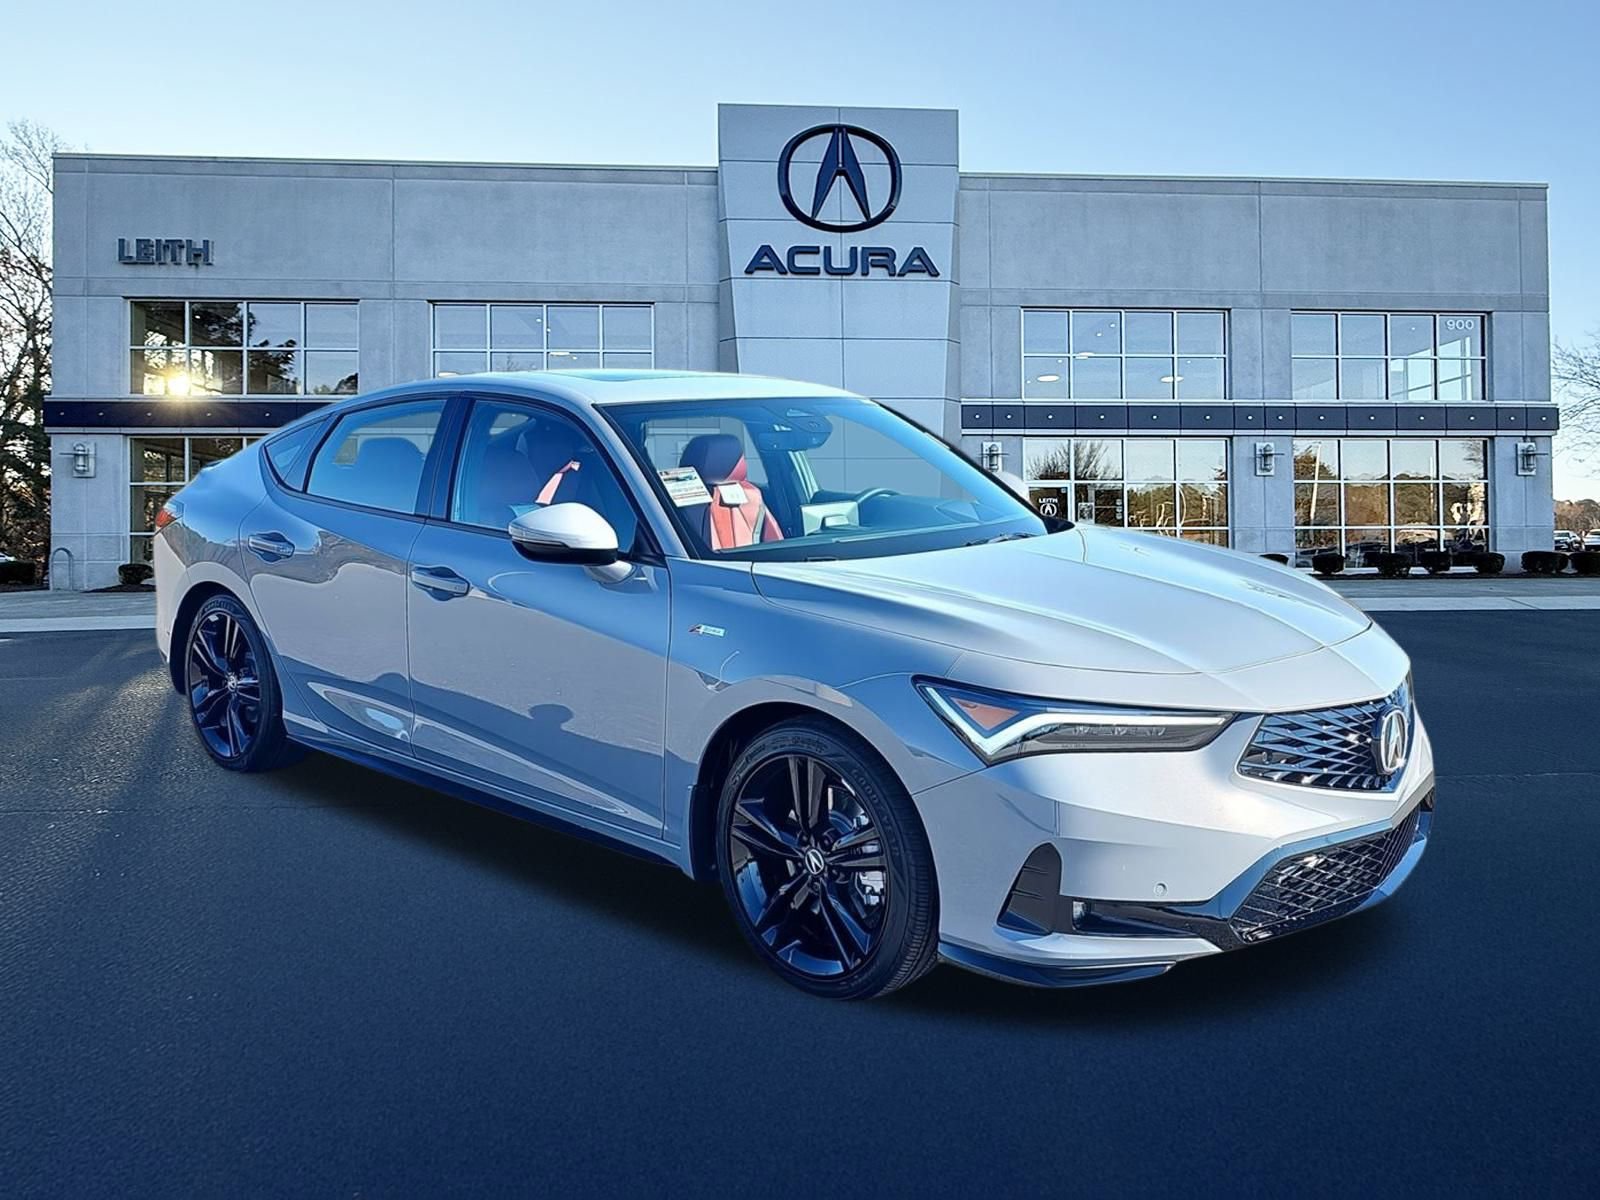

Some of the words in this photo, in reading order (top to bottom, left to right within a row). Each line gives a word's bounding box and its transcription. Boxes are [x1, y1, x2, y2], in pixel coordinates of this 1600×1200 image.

[118, 238, 212, 264] LEITH
[744, 245, 940, 277] ACURA
[1446, 319, 1474, 330] 900
